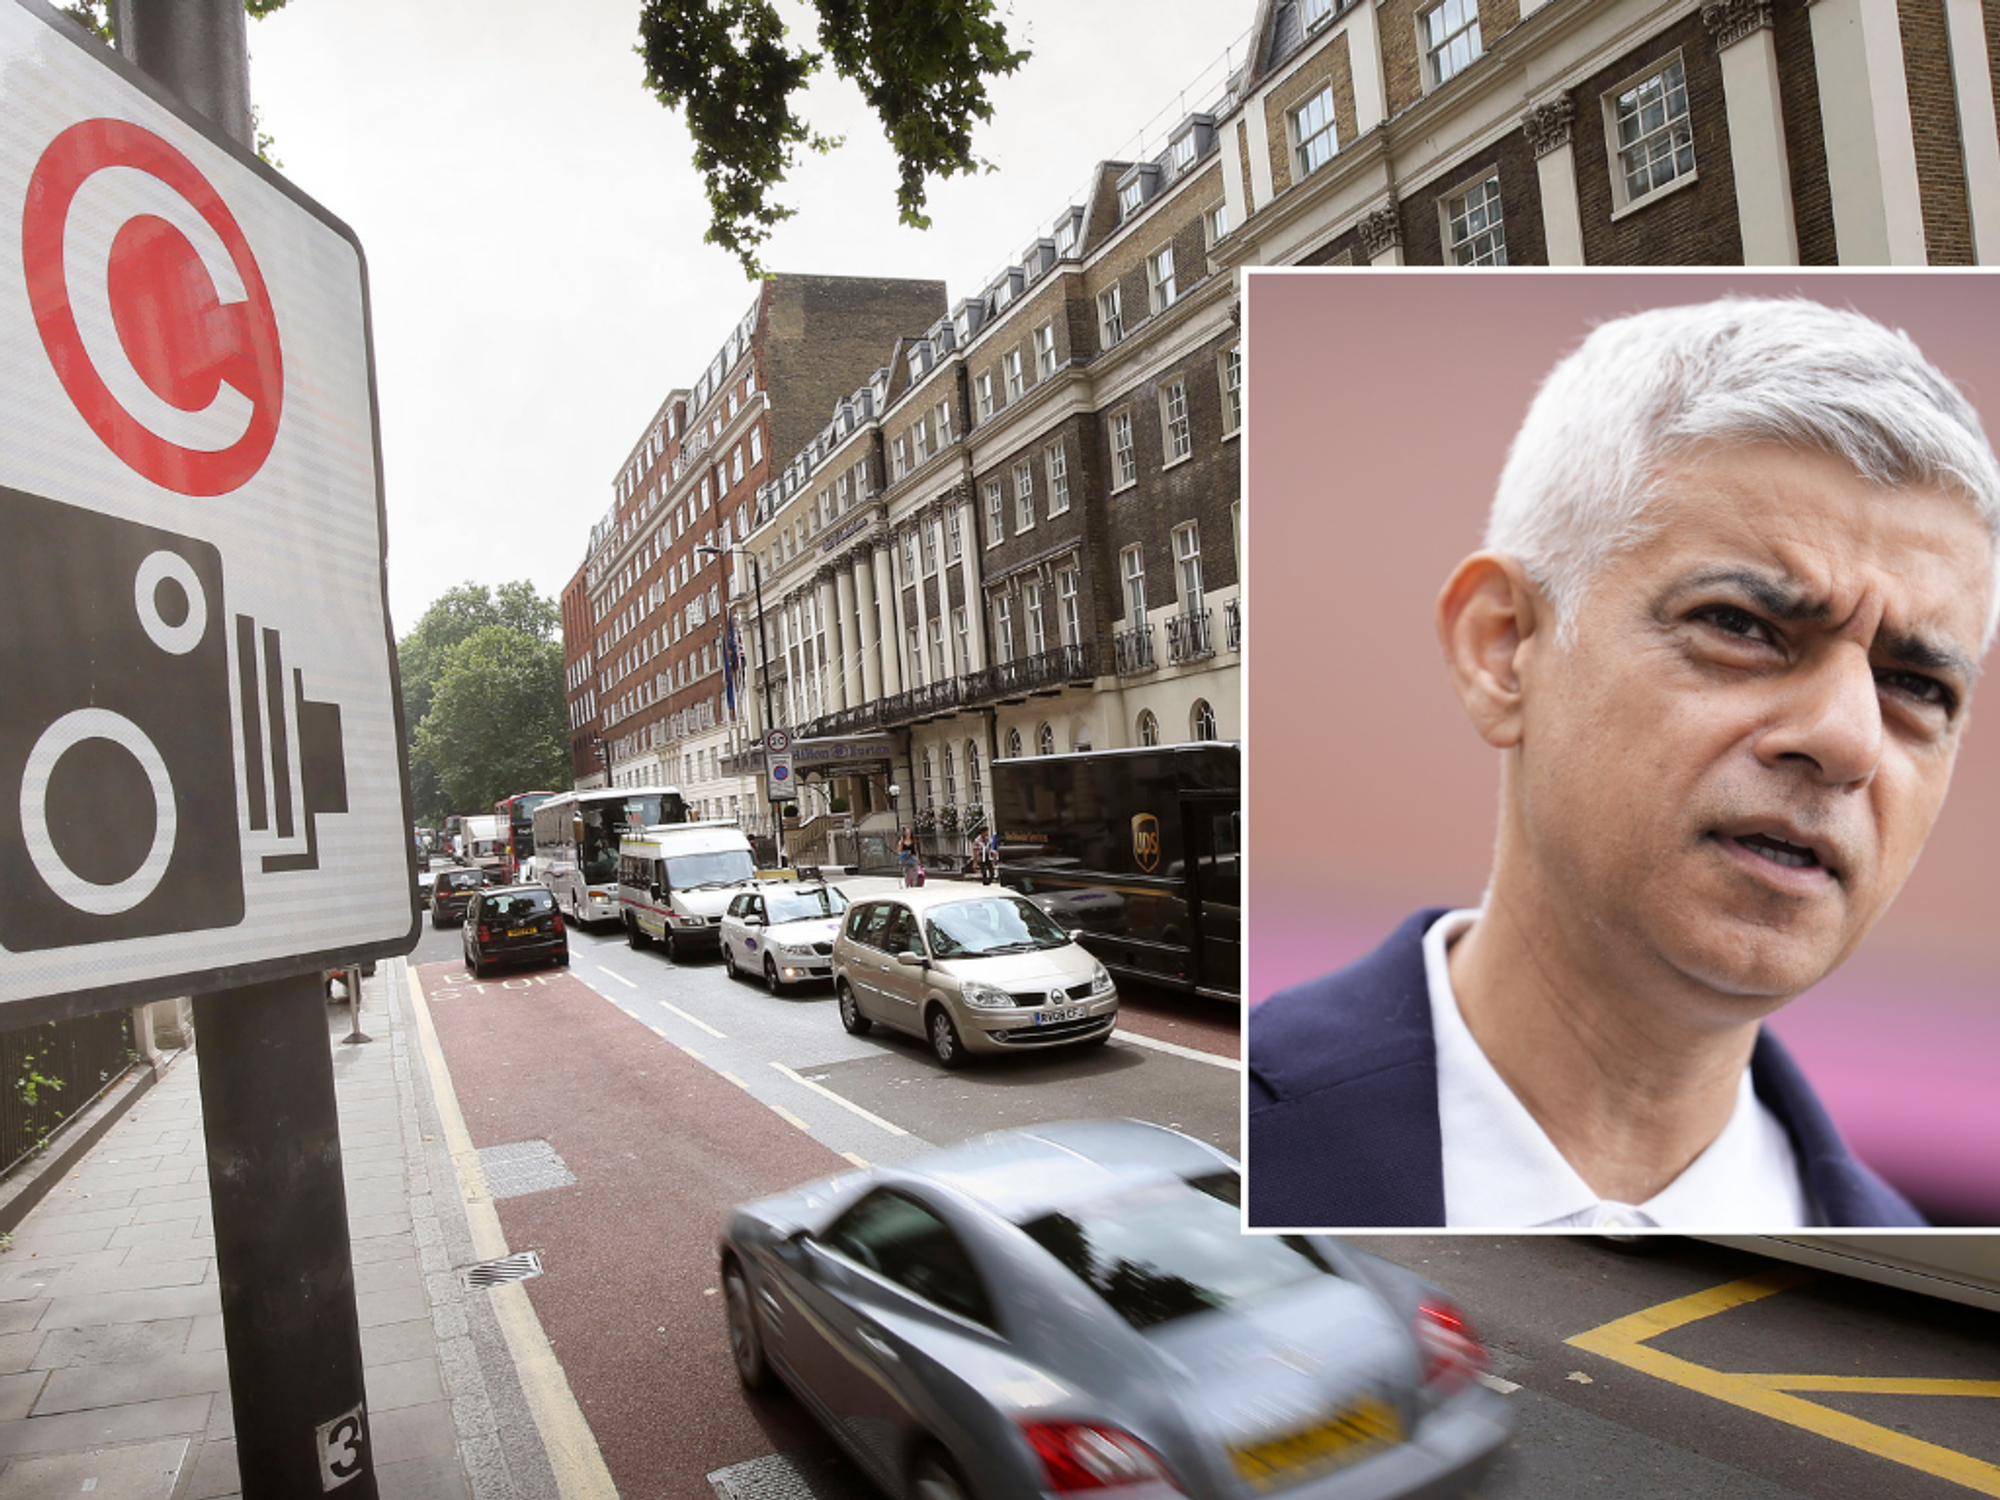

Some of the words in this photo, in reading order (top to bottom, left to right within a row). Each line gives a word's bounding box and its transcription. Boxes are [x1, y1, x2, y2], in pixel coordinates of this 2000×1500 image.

[63, 165, 256, 453] C
[792, 747, 829, 760] Hilton
[848, 744, 890, 757] Euston
[430, 972, 564, 1002] STOP
[328, 1416, 363, 1478] 3
